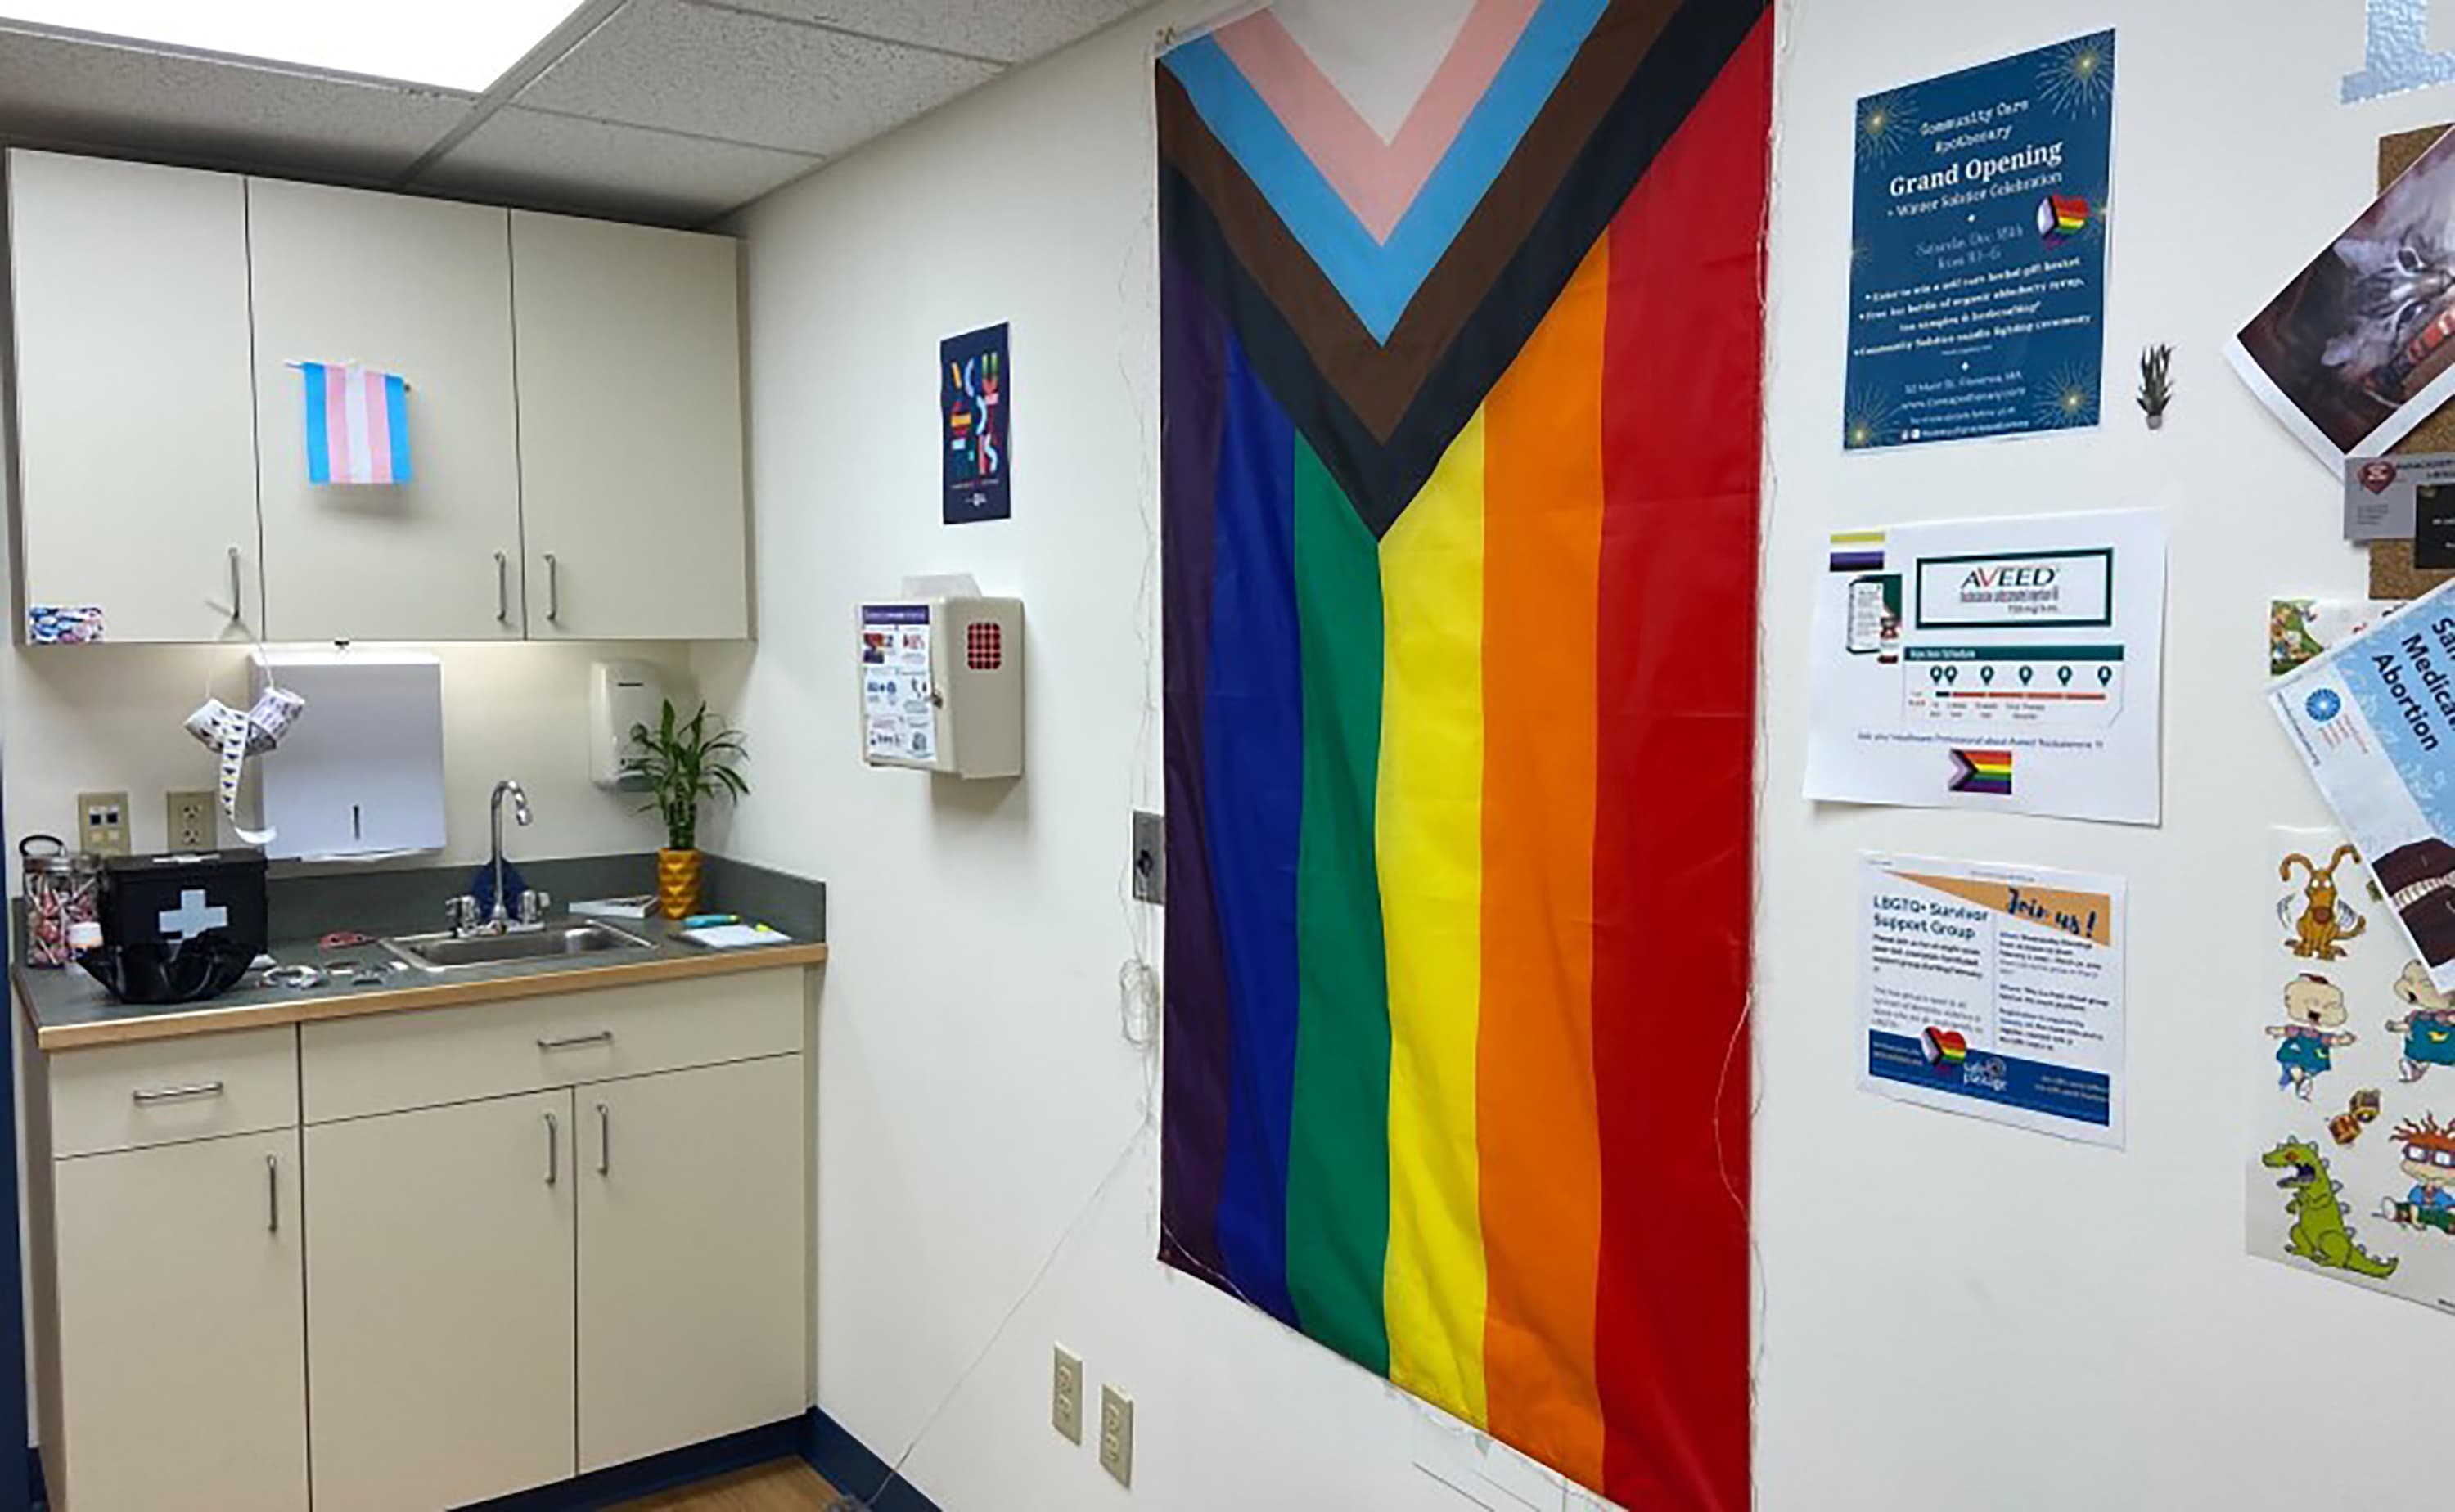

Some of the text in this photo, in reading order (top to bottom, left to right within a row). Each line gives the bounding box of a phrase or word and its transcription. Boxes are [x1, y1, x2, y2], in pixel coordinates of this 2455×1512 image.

[1890, 141, 2063, 197] Grand Opening
[2372, 654, 2439, 752] Abortion
[1930, 902, 1989, 922] Survivor
[2007, 886, 2050, 918] Join
[1873, 912, 1928, 933] Support
[1930, 919, 1976, 940] Group
